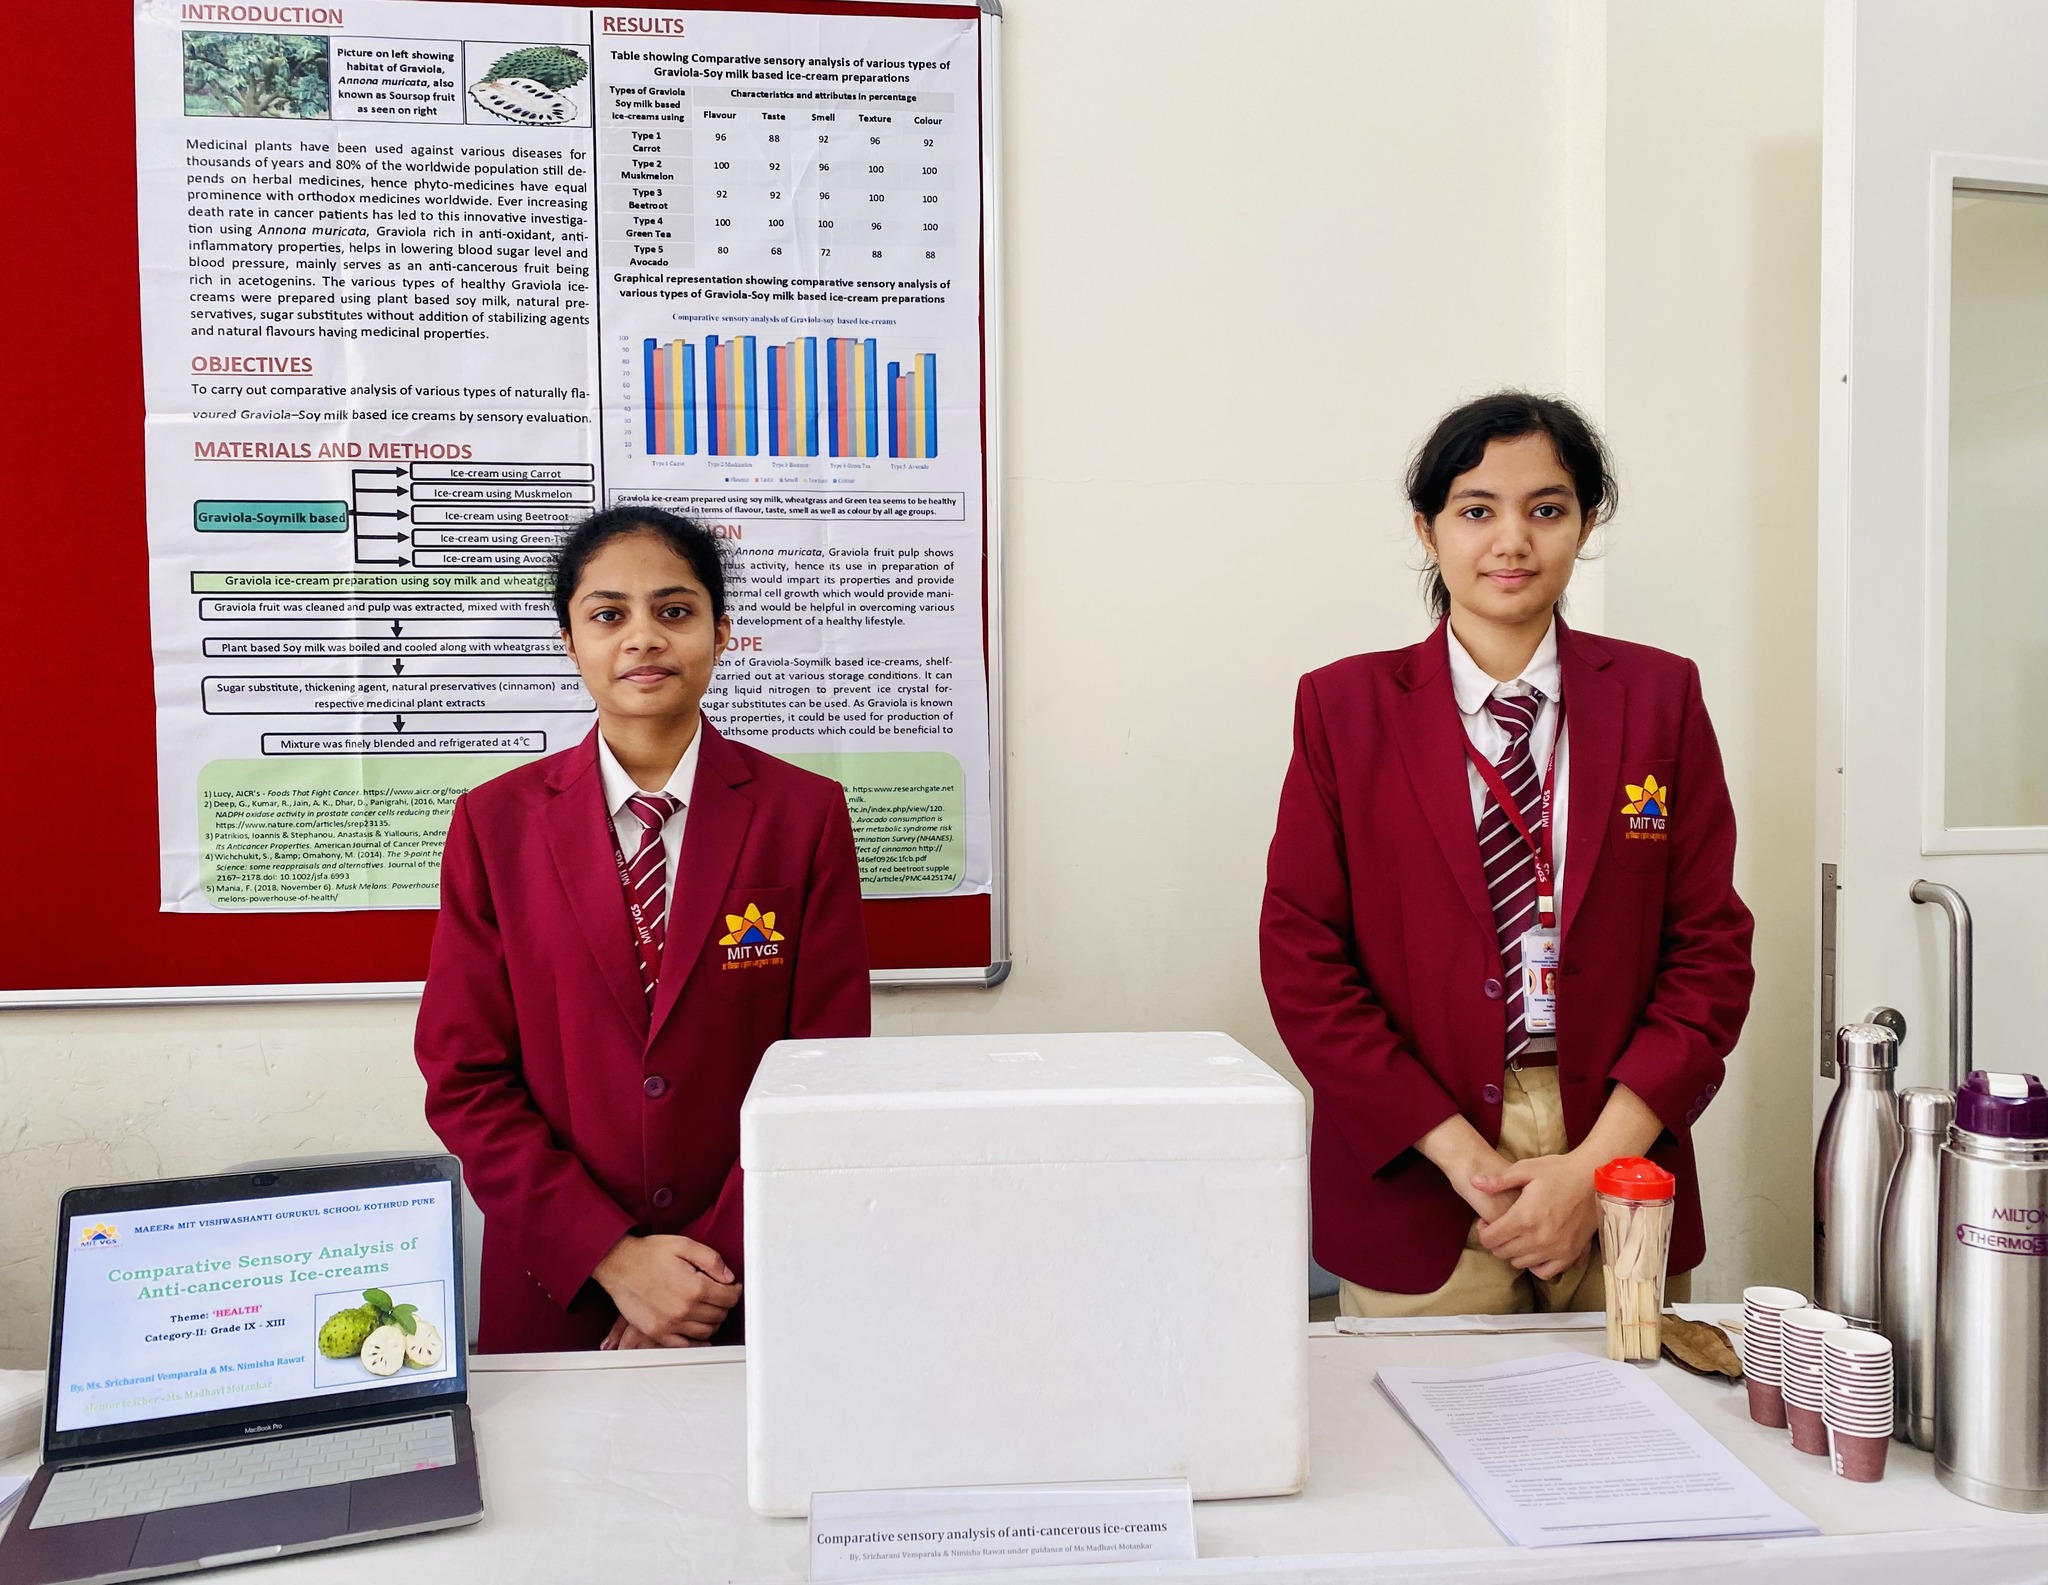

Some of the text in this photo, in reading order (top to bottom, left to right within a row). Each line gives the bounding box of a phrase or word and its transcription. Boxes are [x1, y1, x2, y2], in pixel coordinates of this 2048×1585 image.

[181, 4, 343, 24] INTRODUCTION
[603, 17, 684, 34] RESULTS
[337, 48, 454, 62] Picture on left showing
[610, 50, 950, 70] Table showing Comparative sensory analysis of various types of
[346, 61, 445, 74] habitat of Graviola,
[703, 110, 942, 125] Flavour Taste Smell Texture Colour
[186, 138, 586, 160] Medicinal plants have been used against various diseases for
[631, 159, 937, 175] Type 2 100 92 96 100 100
[192, 356, 313, 373] OBJECTIVES
[190, 383, 207, 394] To
[210, 386, 243, 397] carry
[245, 385, 267, 395] out
[270, 384, 346, 397] comparative
[350, 383, 397, 397] analysis
[399, 384, 412, 395] of
[414, 385, 460, 396] various
[462, 386, 496, 399] types
[499, 386, 512, 397] of
[514, 386, 567, 400] naturally
[194, 441, 472, 459] MATERIALS AND METHODS
[434, 488, 572, 499] Ice-cream using Muskmelon
[198, 512, 345, 526] Graviola-Soymilk based
[736, 546, 954, 559] Annona muricata, Graviola fruit pulp shows
[280, 739, 320, 748] Mixture
[344, 738, 371, 749] finely
[373, 738, 415, 748] blended
[417, 738, 436, 747] and
[439, 737, 498, 748] refrigerated
[500, 738, 511, 746] at
[312, 790, 329, 798] Fight
[1542, 790, 1550, 810] VGS
[1630, 817, 1665, 829] MIT VGS
[615, 850, 631, 886] MIT VGS
[631, 904, 652, 944] MIT VGS
[728, 944, 778, 960] MIT VGS
[177, 1221, 196, 1229] MIT
[198, 1213, 272, 1227] VISHWASHANTI
[274, 1208, 320, 1219] GURUKUL
[322, 1204, 361, 1214] SCHOOL
[363, 1200, 409, 1211] KOTHRUD
[411, 1197, 435, 1206] PUNE
[107, 1236, 419, 1286] Comparative Sensory Analysis of
[137, 1262, 389, 1300] Anti-cancerous Ice-creams
[169, 1312, 208, 1323] Theme:
[210, 1324, 240, 1334] Grade
[244, 1321, 256, 1330] IX
[265, 1318, 285, 1328] XIII
[86, 1381, 102, 1390] Ms.
[104, 1374, 155, 1388] Sricharani
[156, 1367, 207, 1381] Vemparala
[209, 1366, 217, 1374] &
[218, 1364, 235, 1373] Ms.
[236, 1359, 274, 1370] Nimisha
[276, 1355, 304, 1366] Rawat
[166, 1393, 182, 1402] Ms.
[185, 1386, 224, 1399] Madhavi
[245, 1425, 271, 1433] MacBook
[816, 1522, 1167, 1546] Comparative sensory analysis of anti-cancerous ice-creams
[862, 1552, 900, 1560] Sricharani
[901, 1549, 941, 1560] Vemparala
[950, 1548, 980, 1557] Nimisha
[982, 1548, 1005, 1556] Rawat
[1006, 1546, 1029, 1554] under
[1030, 1545, 1063, 1555] guidance
[1064, 1544, 1072, 1552] of
[1073, 1544, 1084, 1552] Ms
[1086, 1543, 1117, 1551] Madhavi
